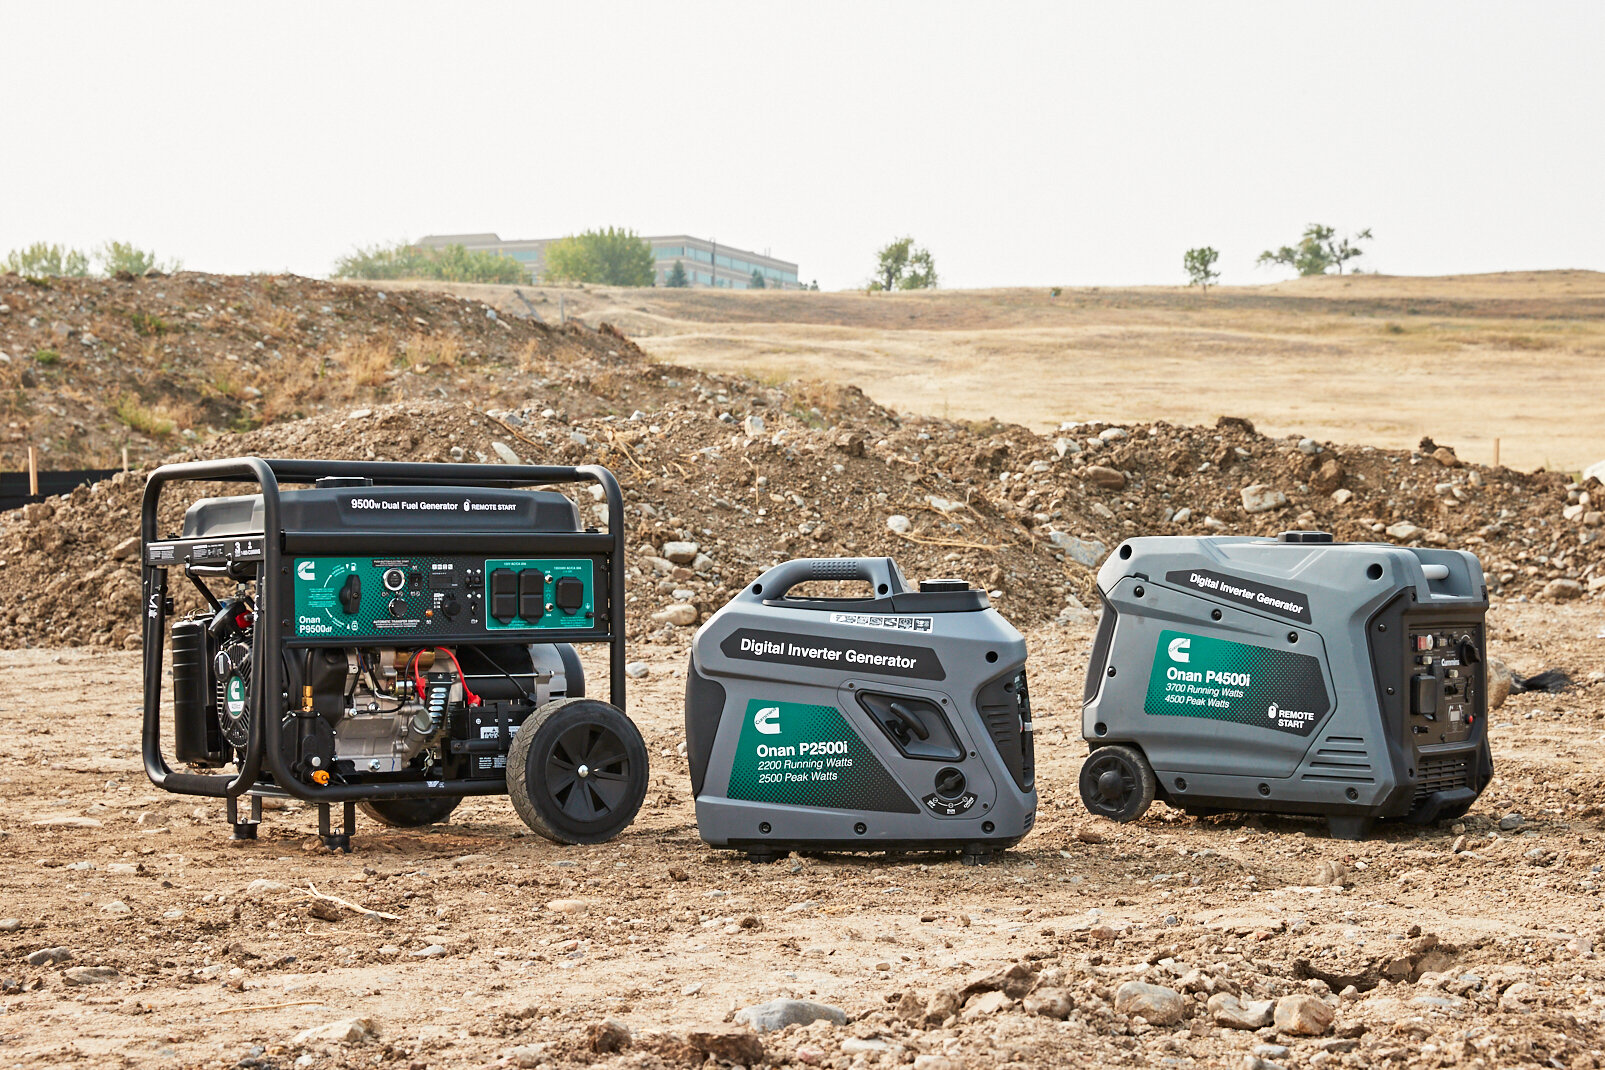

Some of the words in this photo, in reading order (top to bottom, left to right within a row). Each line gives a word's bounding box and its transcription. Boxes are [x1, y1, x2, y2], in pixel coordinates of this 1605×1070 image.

[382, 501, 400, 510] Dual
[401, 502, 418, 510] Fuel
[420, 502, 458, 511] Generator
[471, 503, 497, 511] REMOTE
[497, 503, 516, 511] START
[1190, 573, 1219, 590] Digital
[1220, 581, 1255, 600] Inverter
[1256, 593, 1304, 614] Generator
[299, 616, 321, 624] Onan
[300, 624, 333, 633] P9500df
[740, 638, 785, 656] Digital
[788, 643, 842, 661] Inverter
[845, 650, 917, 669] Generator
[1167, 667, 1202, 682] Onan
[1206, 670, 1250, 687] P4500i
[1166, 683, 1186, 692] 3700
[1187, 685, 1220, 697] Running
[1221, 688, 1244, 698] Watts
[1165, 694, 1184, 704] 4500
[1186, 697, 1206, 706] Peak
[1208, 699, 1230, 708] Watts
[1279, 709, 1315, 721] REMOTE
[1278, 719, 1305, 729] START
[756, 744, 796, 758] Onan
[799, 741, 848, 756] P2500i
[757, 761, 782, 771] 2200
[783, 759, 823, 770] Running
[826, 758, 853, 768] Watts
[758, 773, 783, 784] 2500
[784, 772, 809, 782] Peak
[811, 771, 838, 781] Watts
